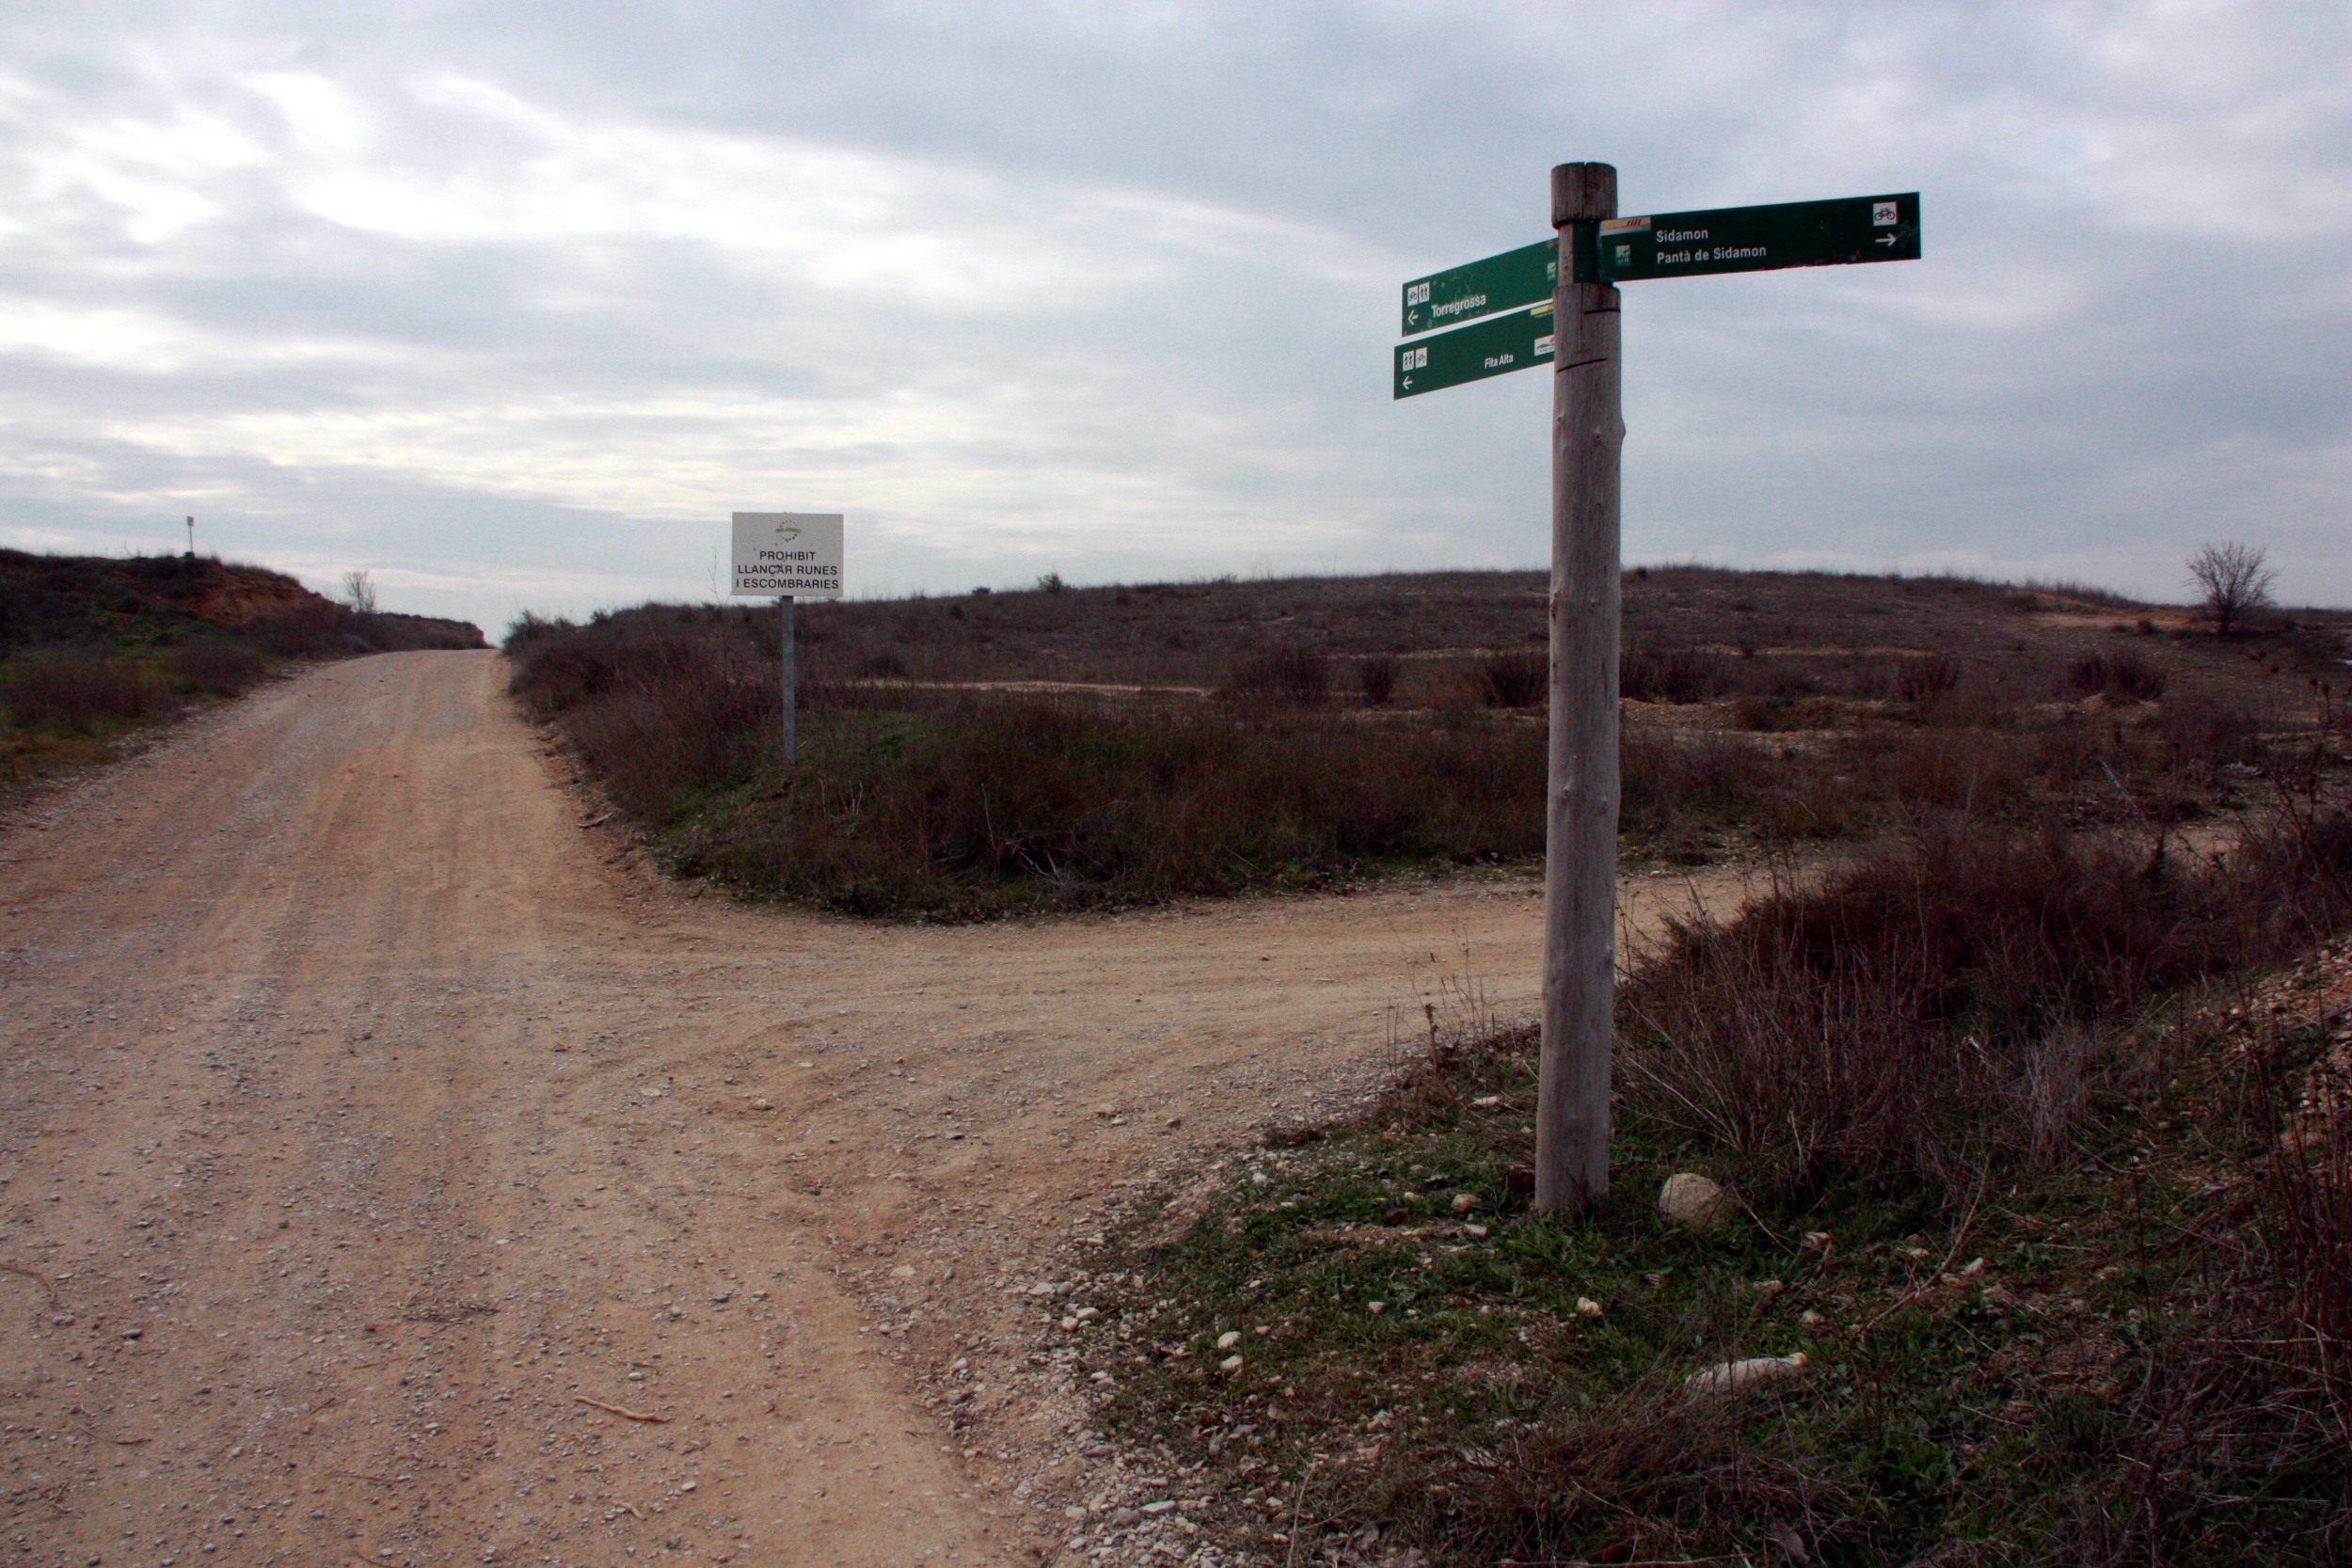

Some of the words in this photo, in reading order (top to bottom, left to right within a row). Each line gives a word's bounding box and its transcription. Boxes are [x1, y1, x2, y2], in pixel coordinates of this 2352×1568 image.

[1656, 229, 1708, 243] Sidamon
[1657, 249, 1691, 264] Pantà
[1694, 250, 1709, 261] de
[1713, 246, 1767, 260] Sidamon
[1431, 294, 1486, 318] Torregrossa
[1485, 356, 1498, 369] Fita
[1499, 354, 1514, 366] Alta
[759, 550, 816, 561] PROHIBIT
[738, 564, 792, 577] LLANÇAR
[797, 565, 837, 575] RUNES
[743, 578, 839, 589] ESCOMBRARIES
